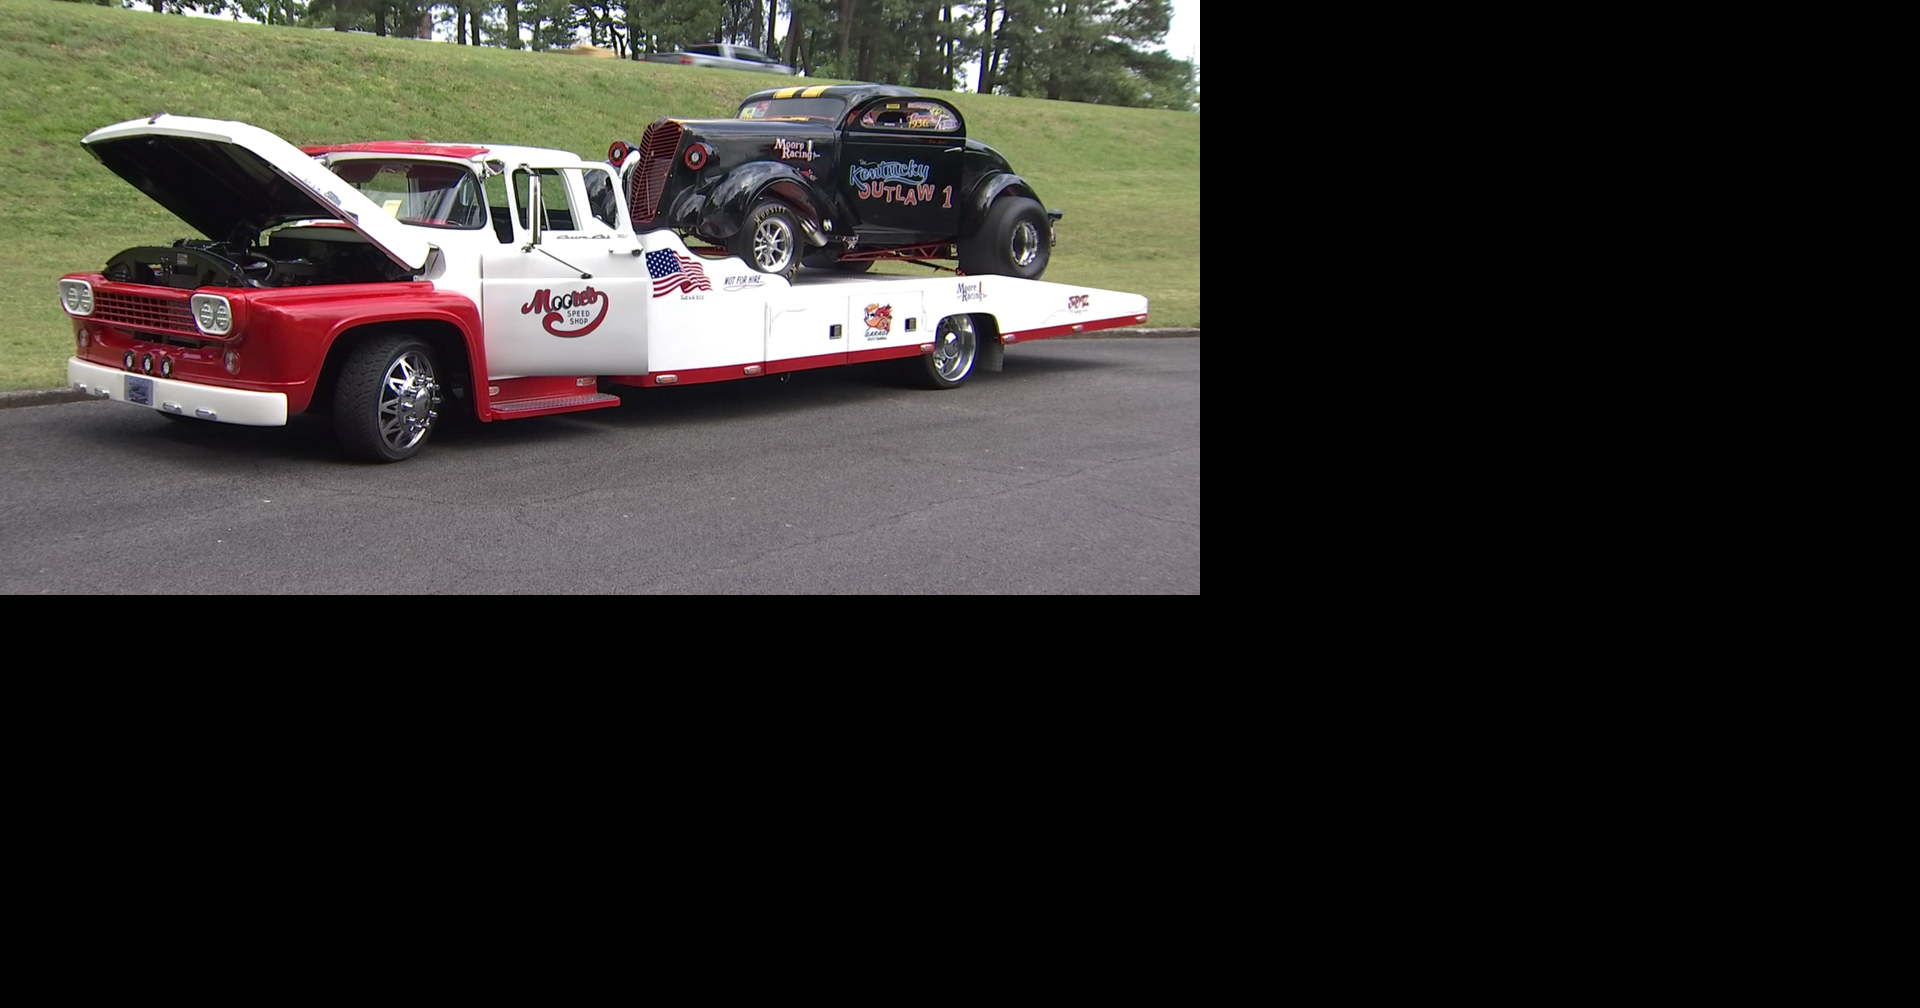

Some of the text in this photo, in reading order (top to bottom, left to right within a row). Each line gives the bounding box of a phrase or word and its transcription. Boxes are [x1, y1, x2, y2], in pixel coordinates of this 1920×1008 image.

[908, 119, 930, 129] 1936
[773, 138, 804, 150] Moore
[781, 149, 812, 161] Racing
[849, 159, 929, 191] Kentucky
[858, 181, 953, 209] OUTLAW 1
[724, 276, 736, 286] NOT
[736, 275, 747, 285] FOR
[956, 282, 977, 294] Moore
[521, 285, 598, 315] Moore's
[567, 310, 590, 318] SPEED
[569, 317, 589, 325] SHOP
